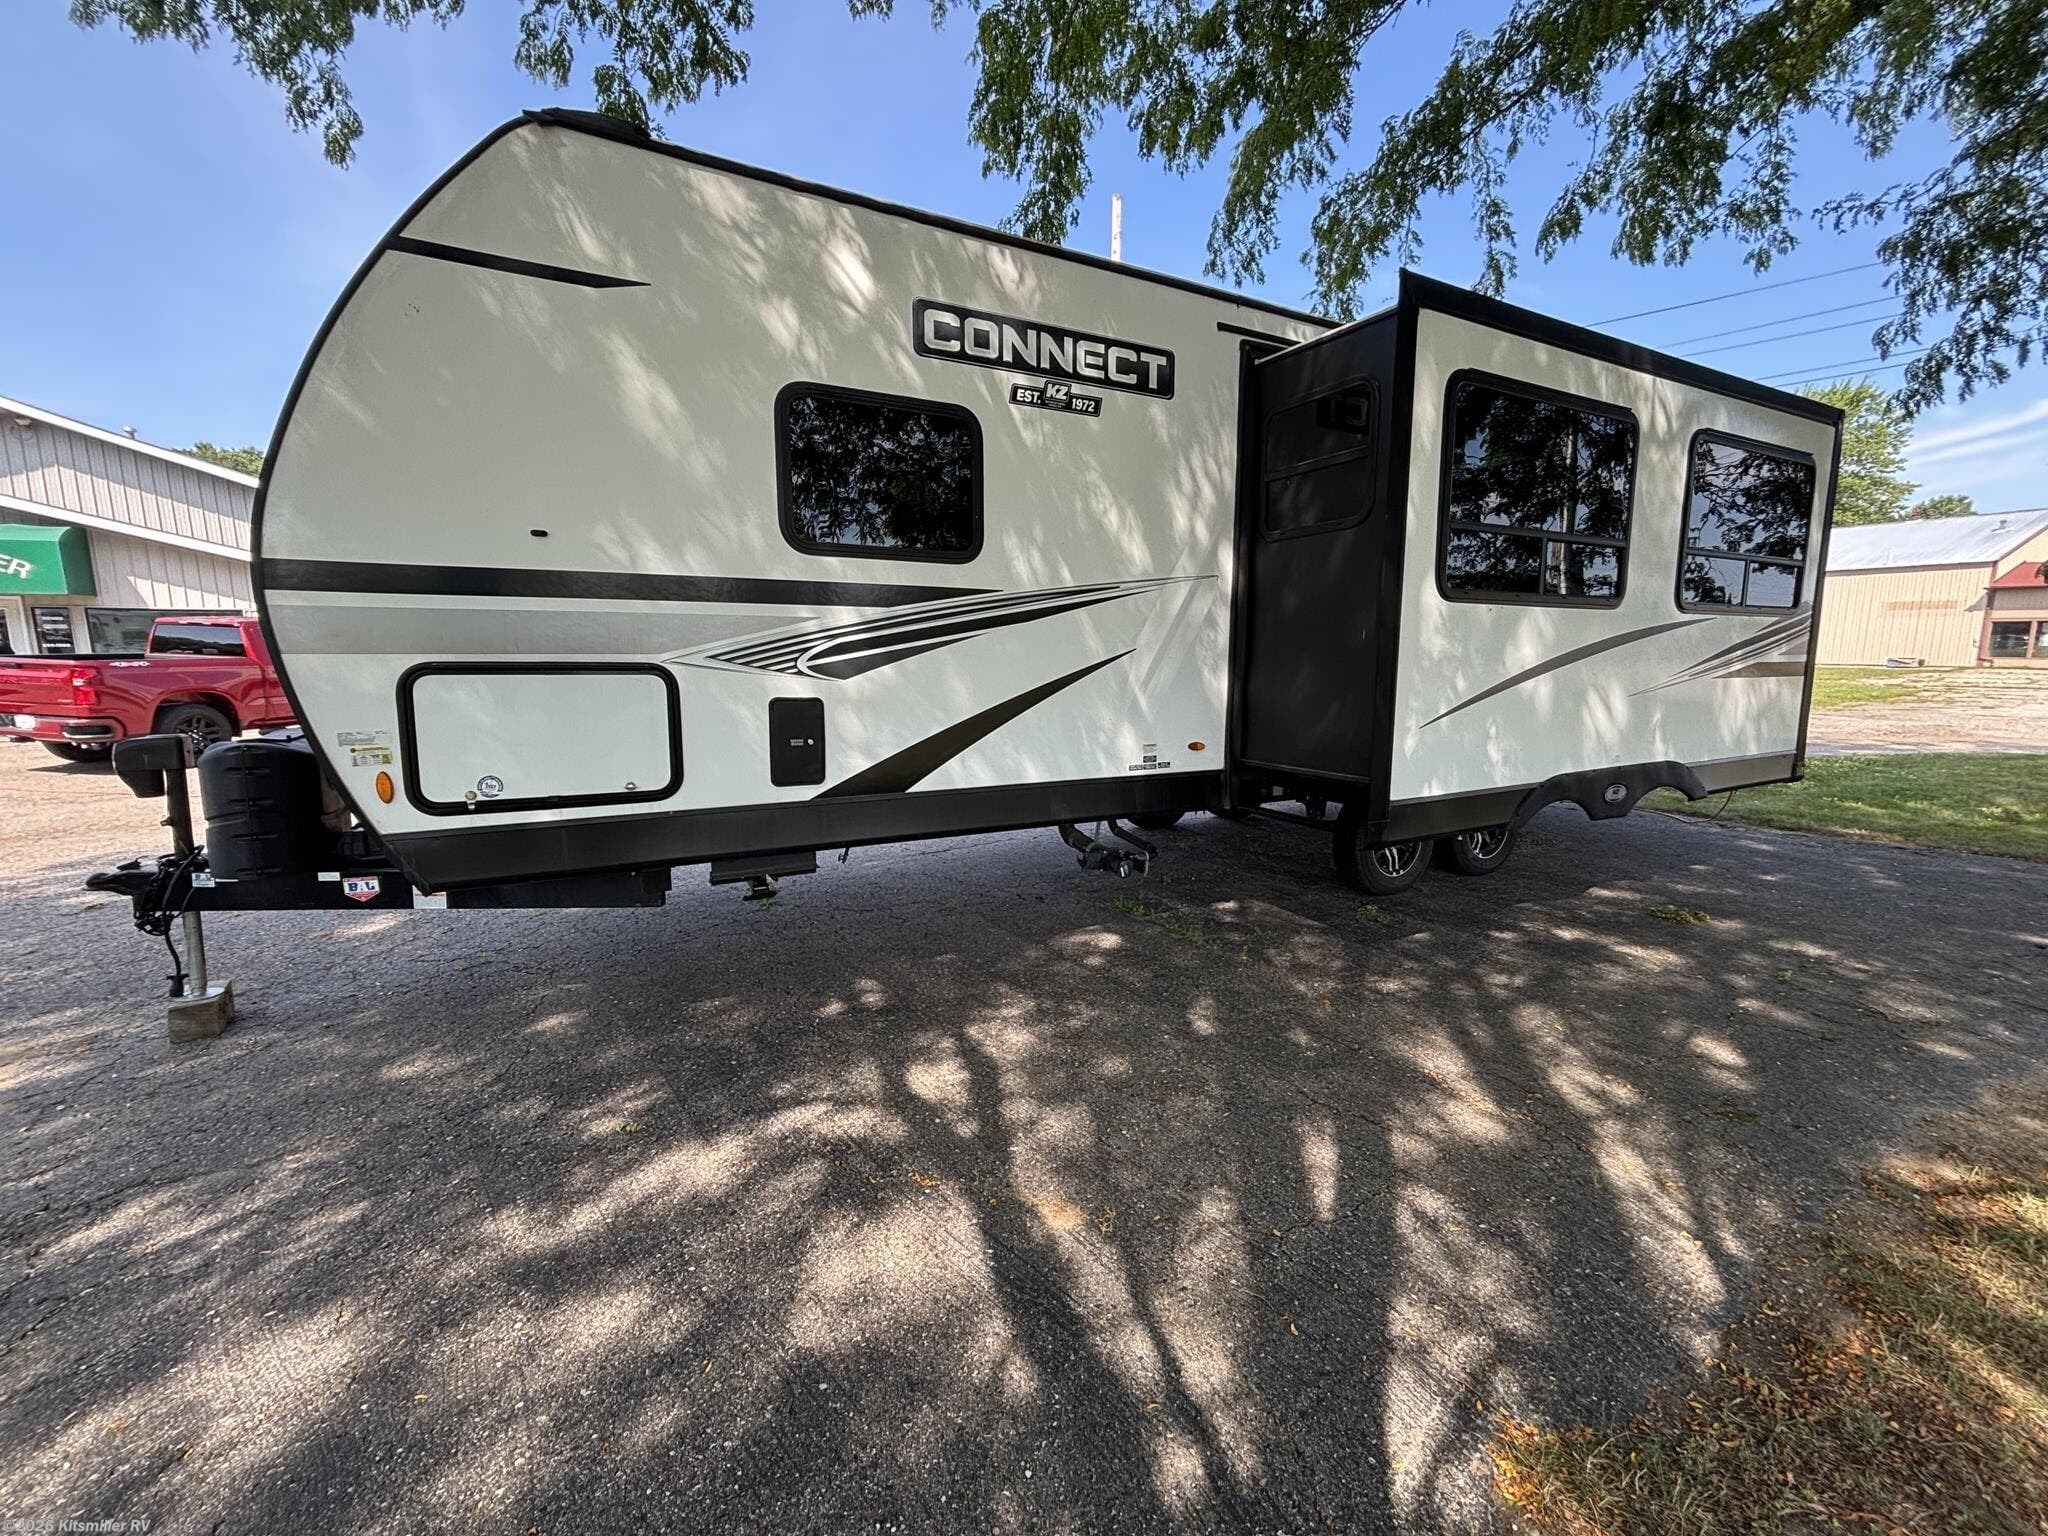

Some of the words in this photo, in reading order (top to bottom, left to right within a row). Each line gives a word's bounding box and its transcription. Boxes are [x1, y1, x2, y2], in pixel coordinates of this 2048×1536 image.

[922, 307, 1168, 390] CONNECT
[1016, 388, 1041, 404] EST.
[1045, 383, 1069, 400] KZ
[1071, 398, 1096, 413] 1972
